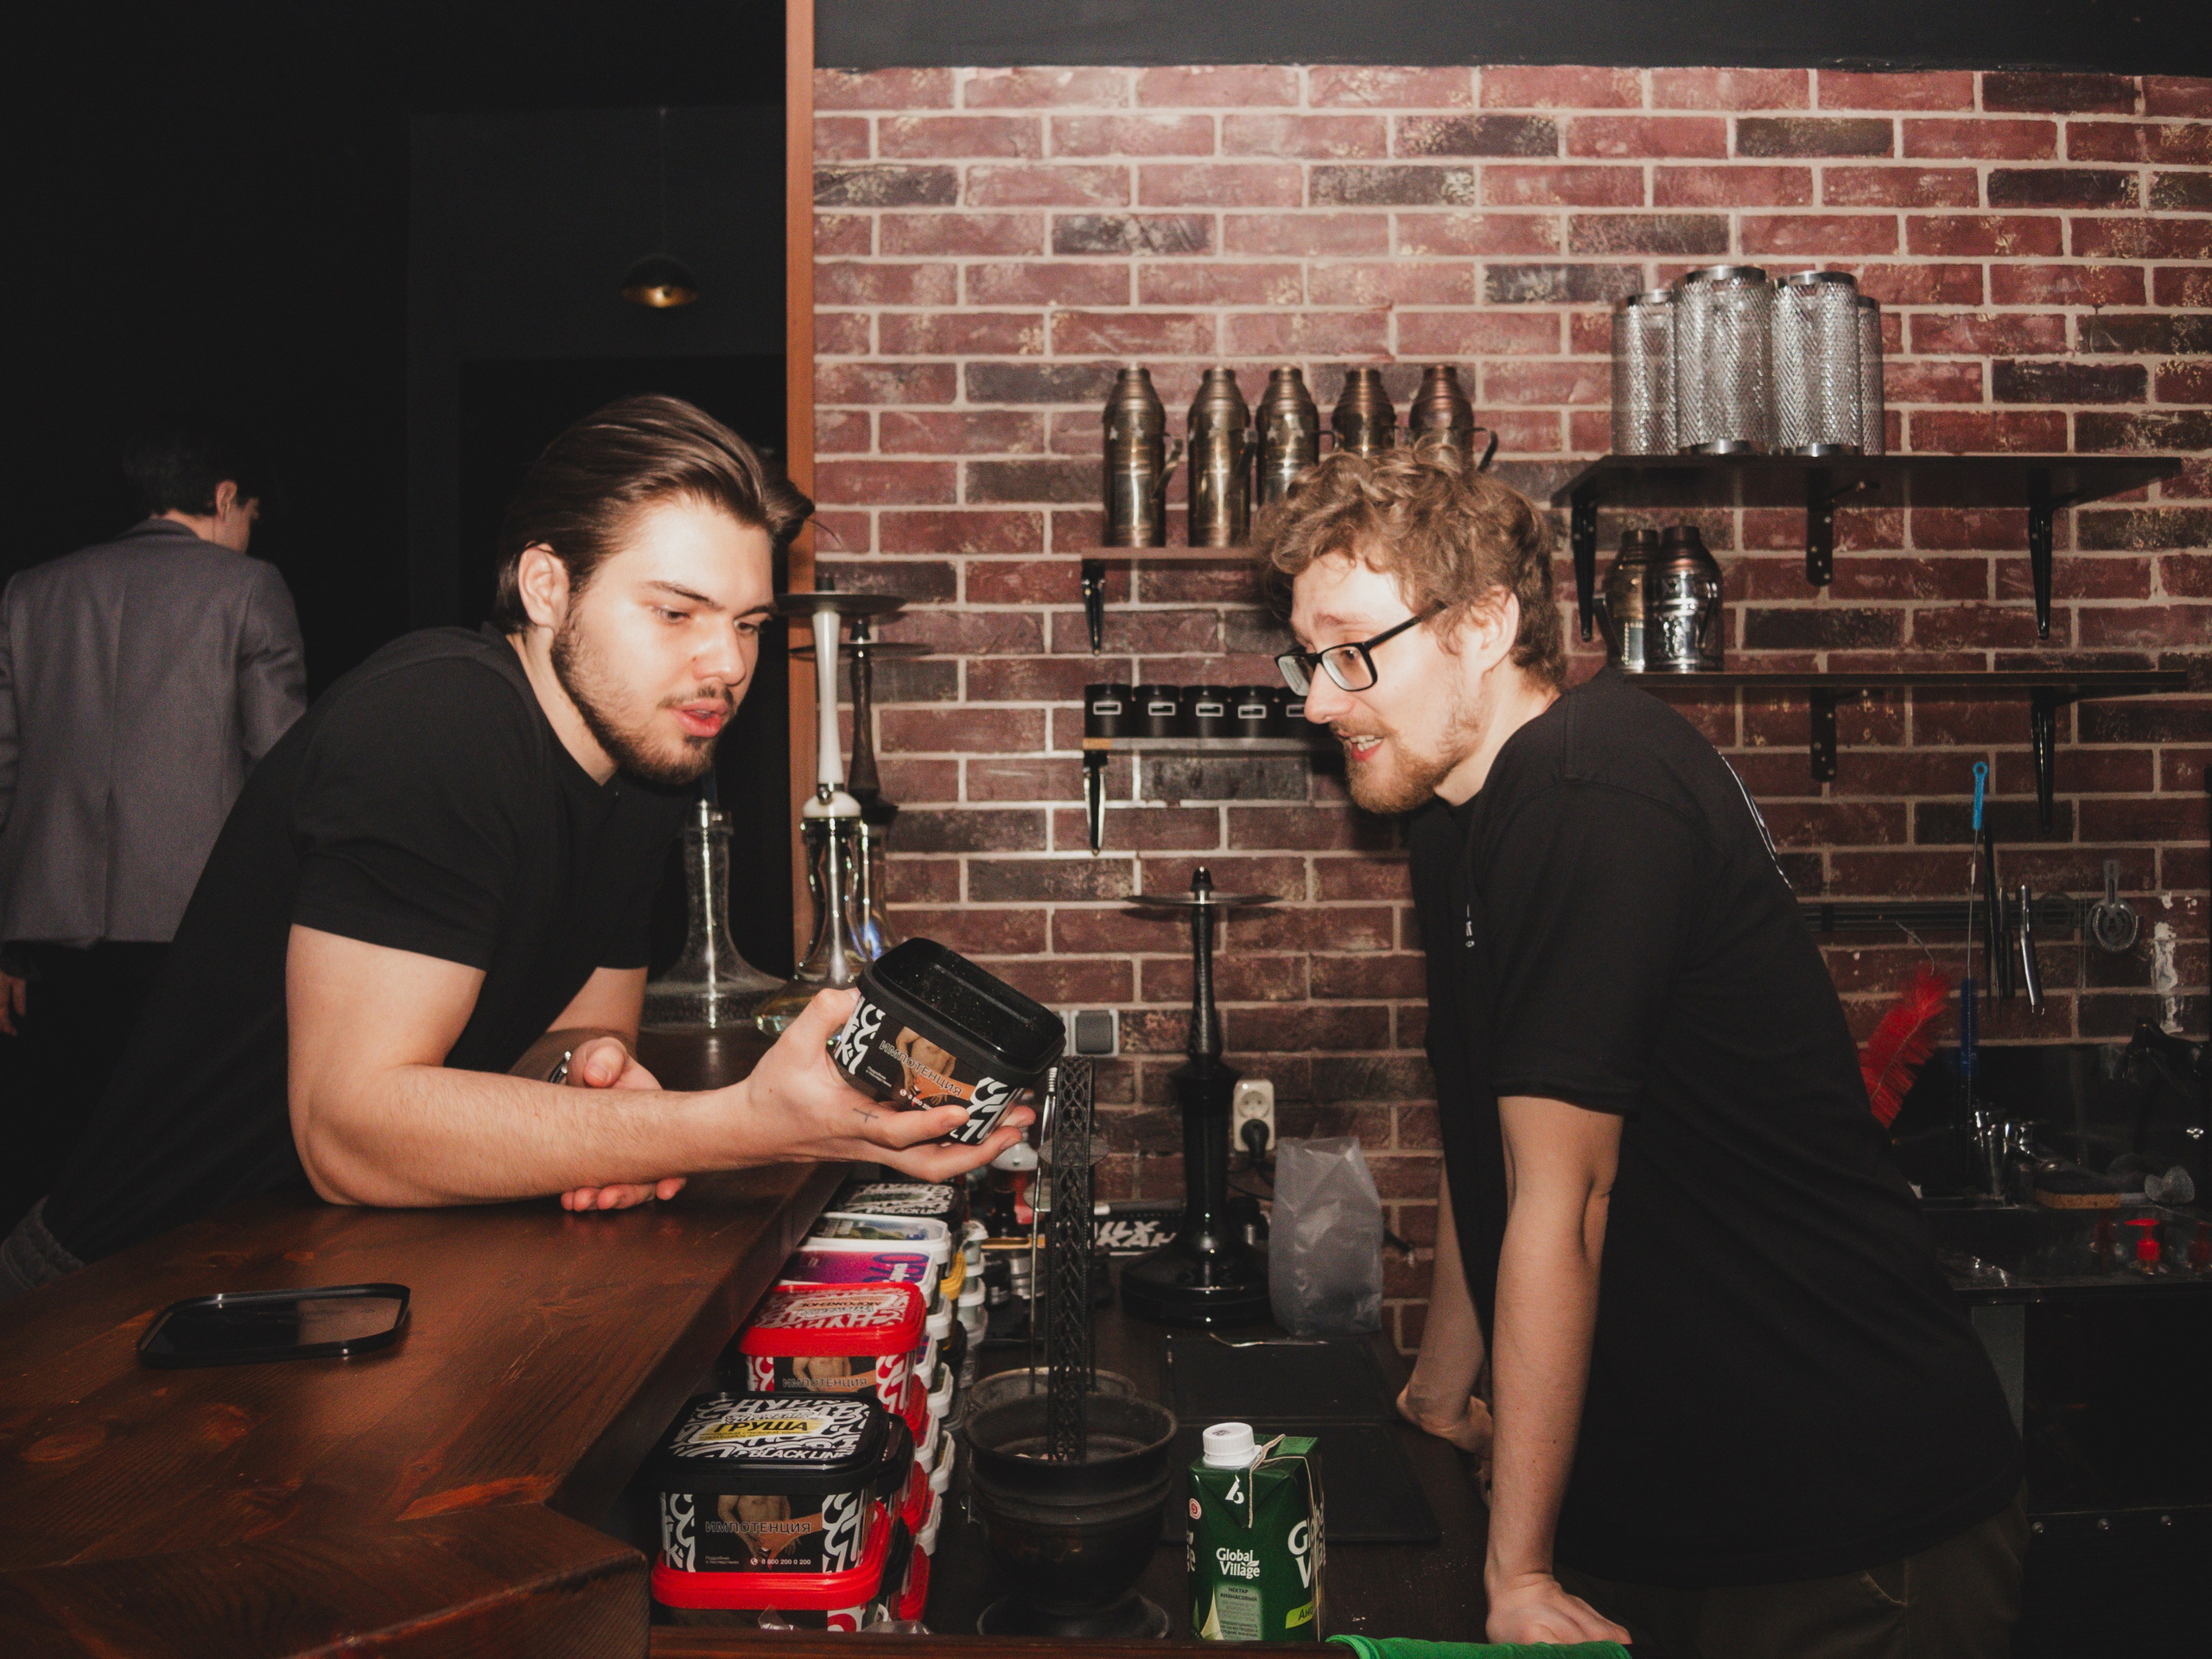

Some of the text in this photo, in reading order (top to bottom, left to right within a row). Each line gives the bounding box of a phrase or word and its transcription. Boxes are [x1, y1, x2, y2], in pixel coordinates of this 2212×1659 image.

[879, 1039, 963, 1096] ИМПОТЕНЦИЯ
[781, 1378, 868, 1389] ИМПОТЕНЦИЯ
[714, 1420, 808, 1433] ГРУША
[748, 1447, 809, 1459] BLACK
[704, 1521, 811, 1535] ИМПОТЕНЦИЯ
[1216, 1547, 1254, 1562] Global
[1219, 1560, 1261, 1580] Village
